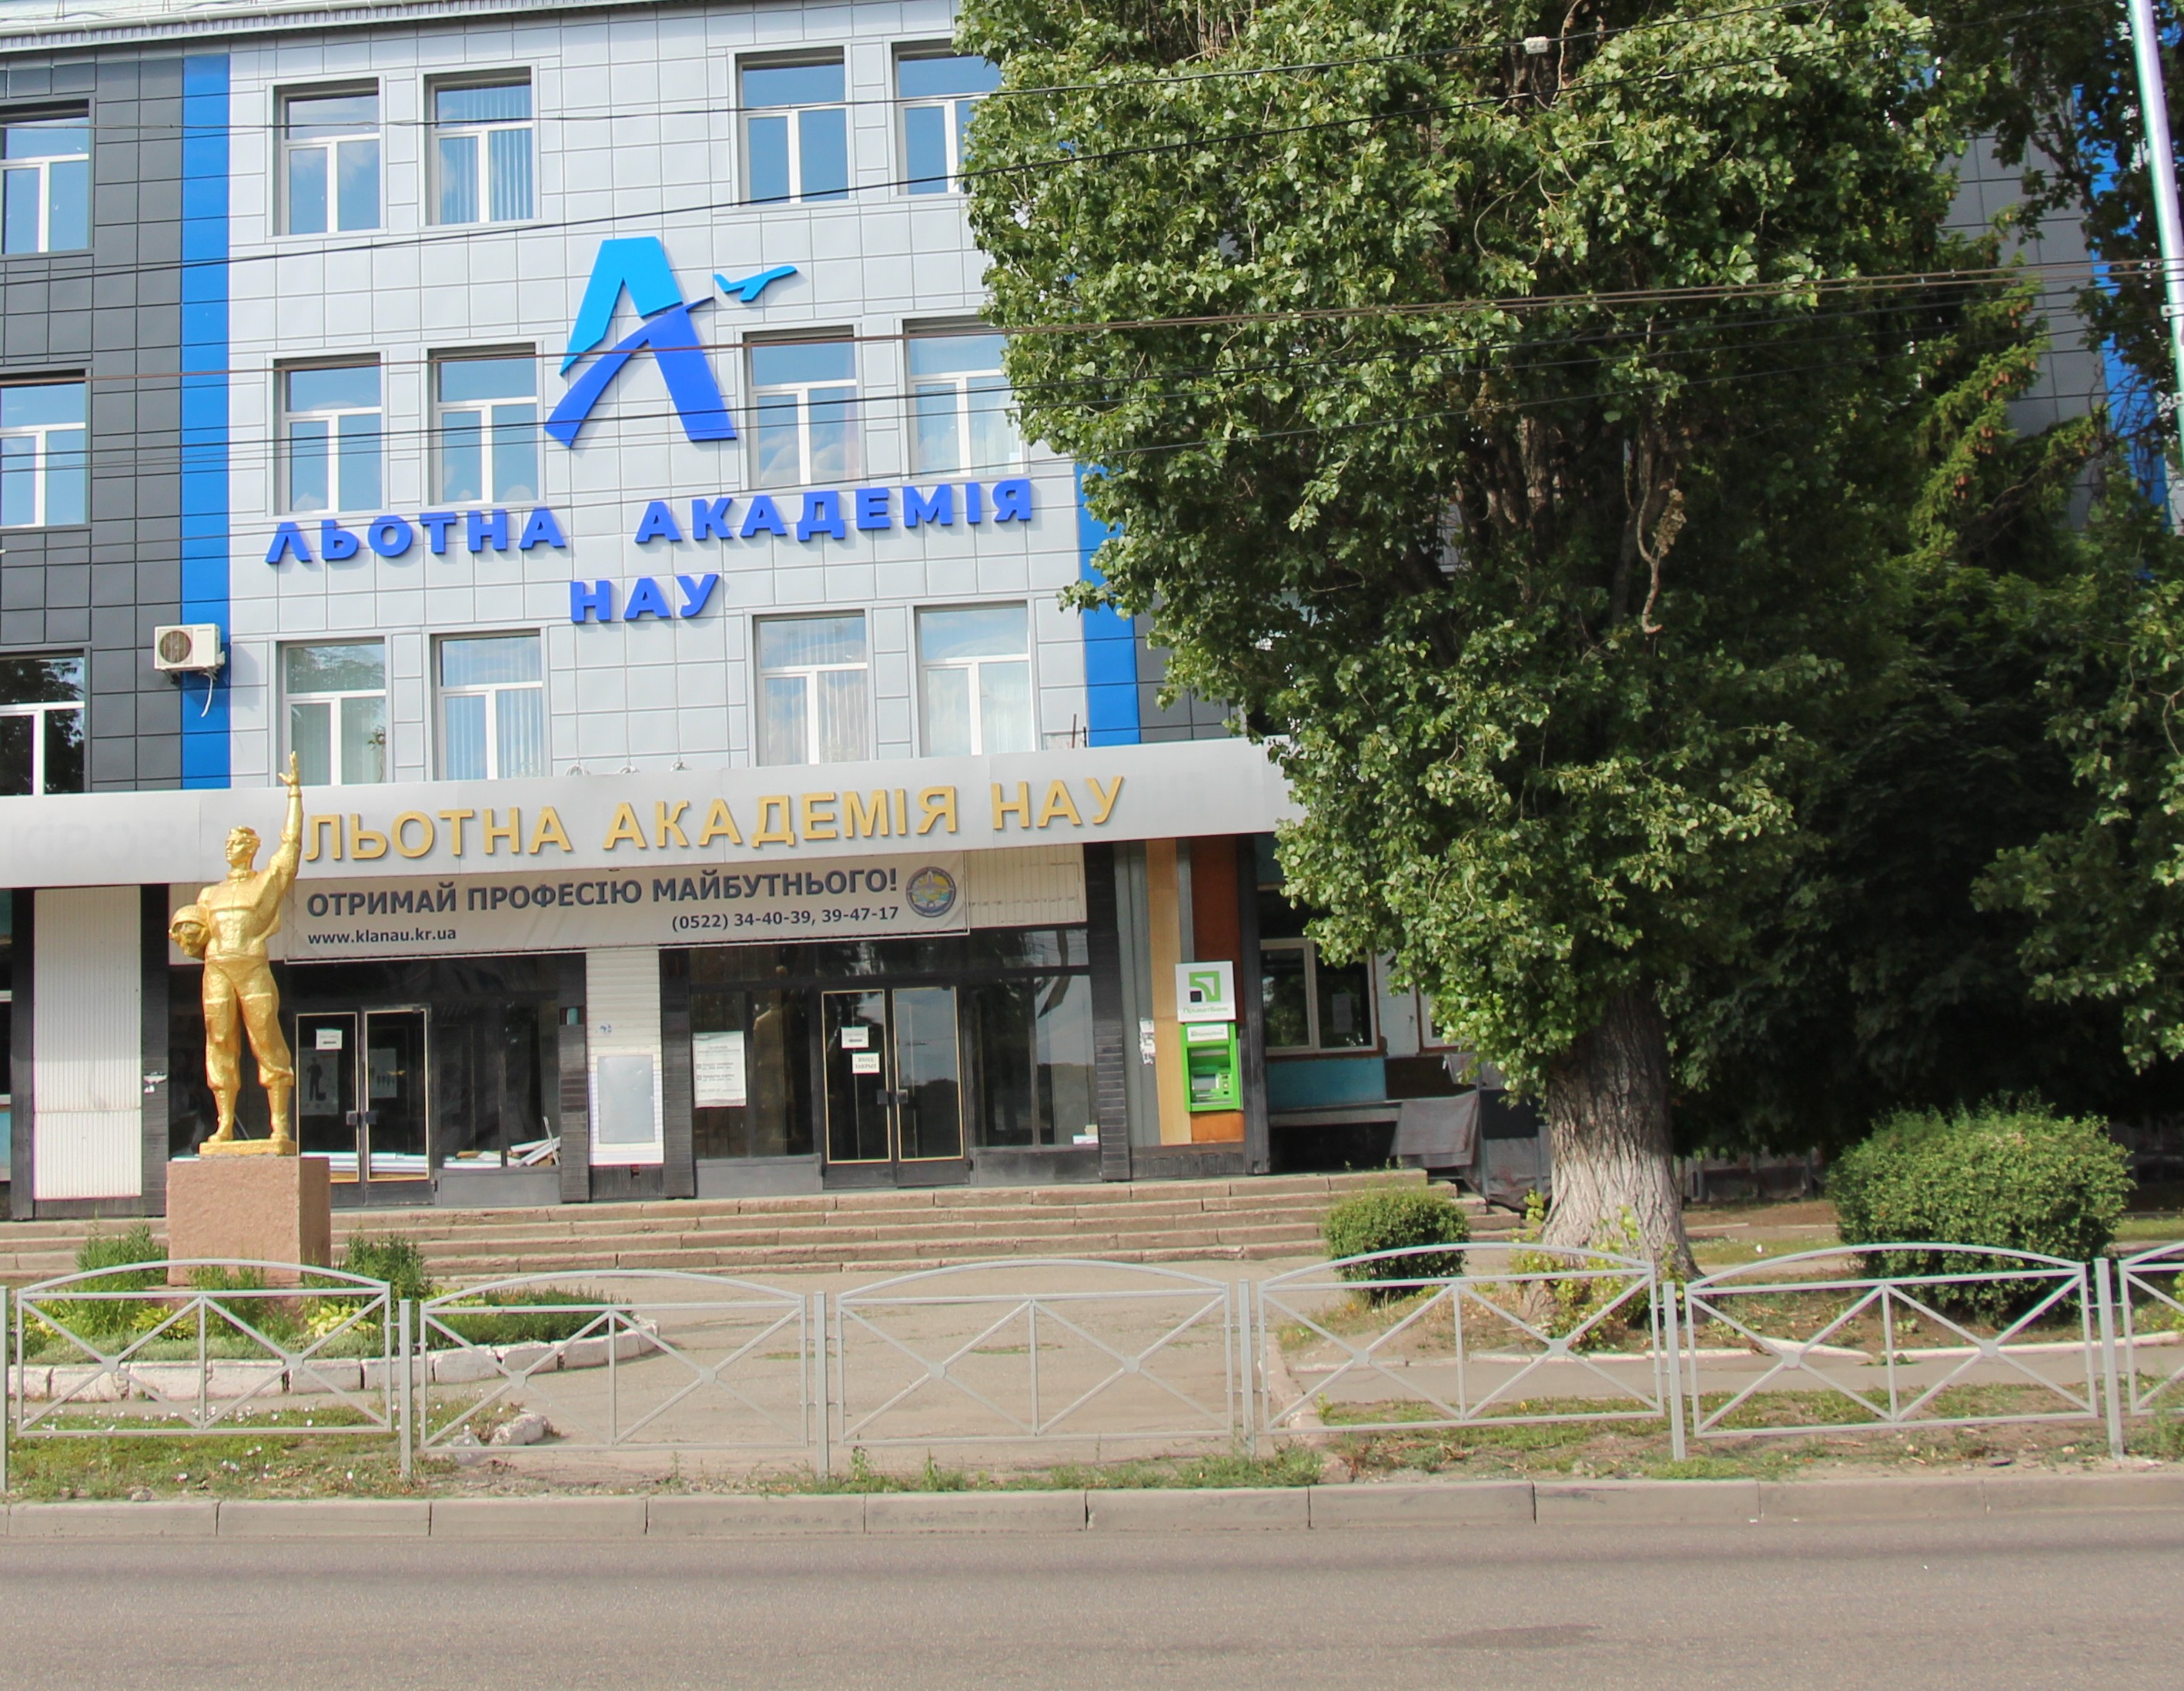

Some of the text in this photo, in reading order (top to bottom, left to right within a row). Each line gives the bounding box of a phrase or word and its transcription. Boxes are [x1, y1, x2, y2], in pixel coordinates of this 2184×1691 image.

[266, 479, 1033, 564] ЛЬОТНА АКАДЕМІЯ
[570, 574, 719, 623] НАУ
[305, 806, 571, 861] ЛЬОТНА
[604, 786, 958, 849] АКАДЕМІЯ
[992, 776, 1125, 829] НАУ
[307, 868, 898, 917] ОТРИМАЙ ПРОФЕСІЮ МАЙБУТНЬОГО!
[308, 927, 457, 944] www.klanau.kr.ua
[672, 906, 899, 932] (0522) 34-40-39, 39-47-17
